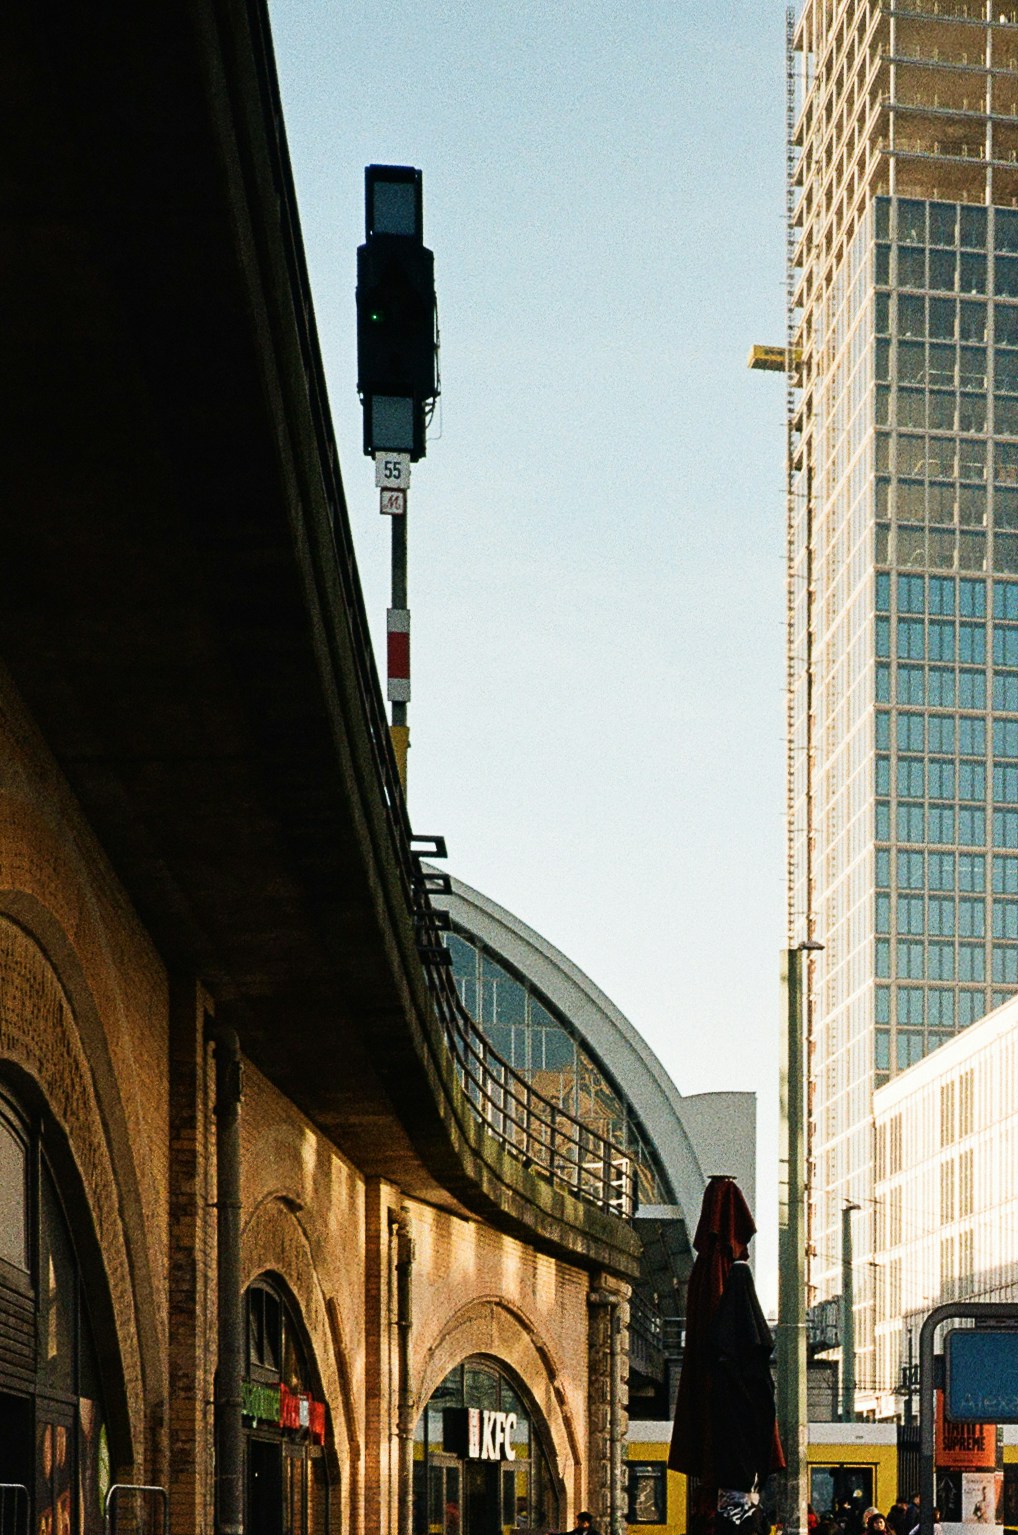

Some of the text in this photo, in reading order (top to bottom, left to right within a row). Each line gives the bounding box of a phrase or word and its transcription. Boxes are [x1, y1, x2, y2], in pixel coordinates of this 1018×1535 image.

[384, 460, 401, 480] 55
[481, 1410, 518, 1461] KFC
[942, 1436, 985, 1451] SUPREME
